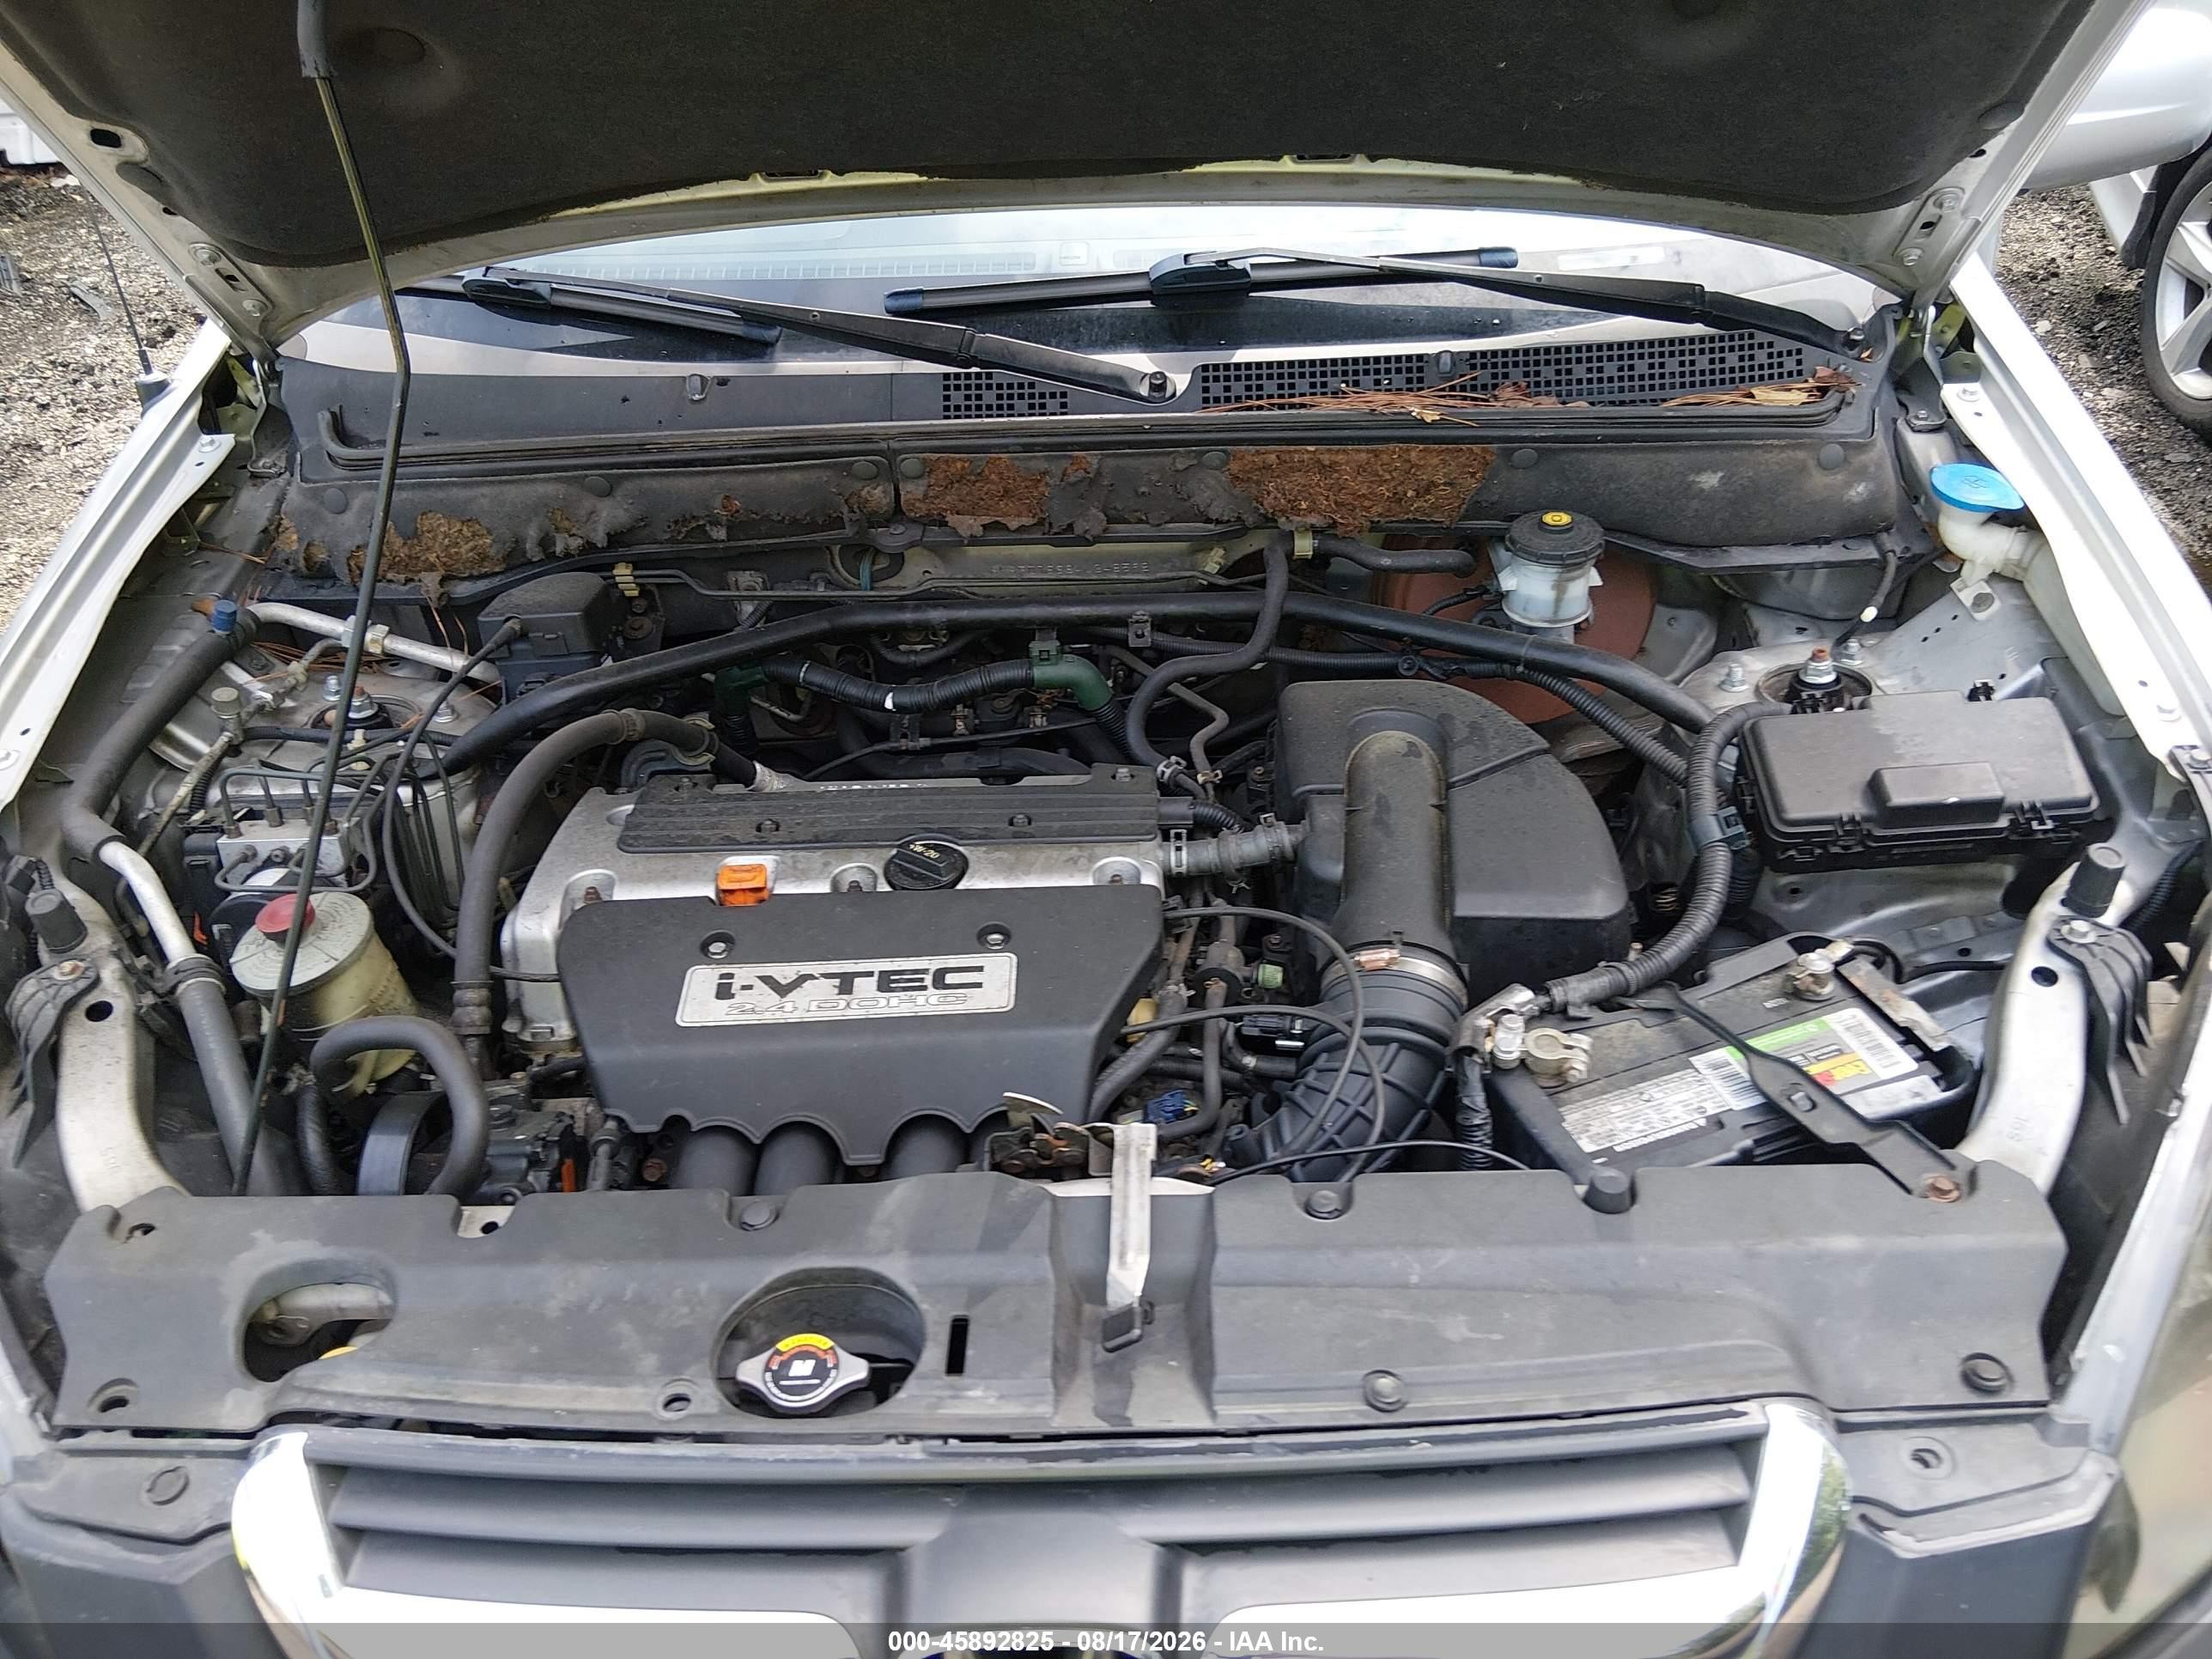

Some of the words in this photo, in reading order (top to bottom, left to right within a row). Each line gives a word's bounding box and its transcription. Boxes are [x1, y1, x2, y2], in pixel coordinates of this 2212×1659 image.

[714, 964, 985, 1001] i-VTEC
[725, 1000, 799, 1017] 2.4
[805, 993, 969, 1012] DOHC
